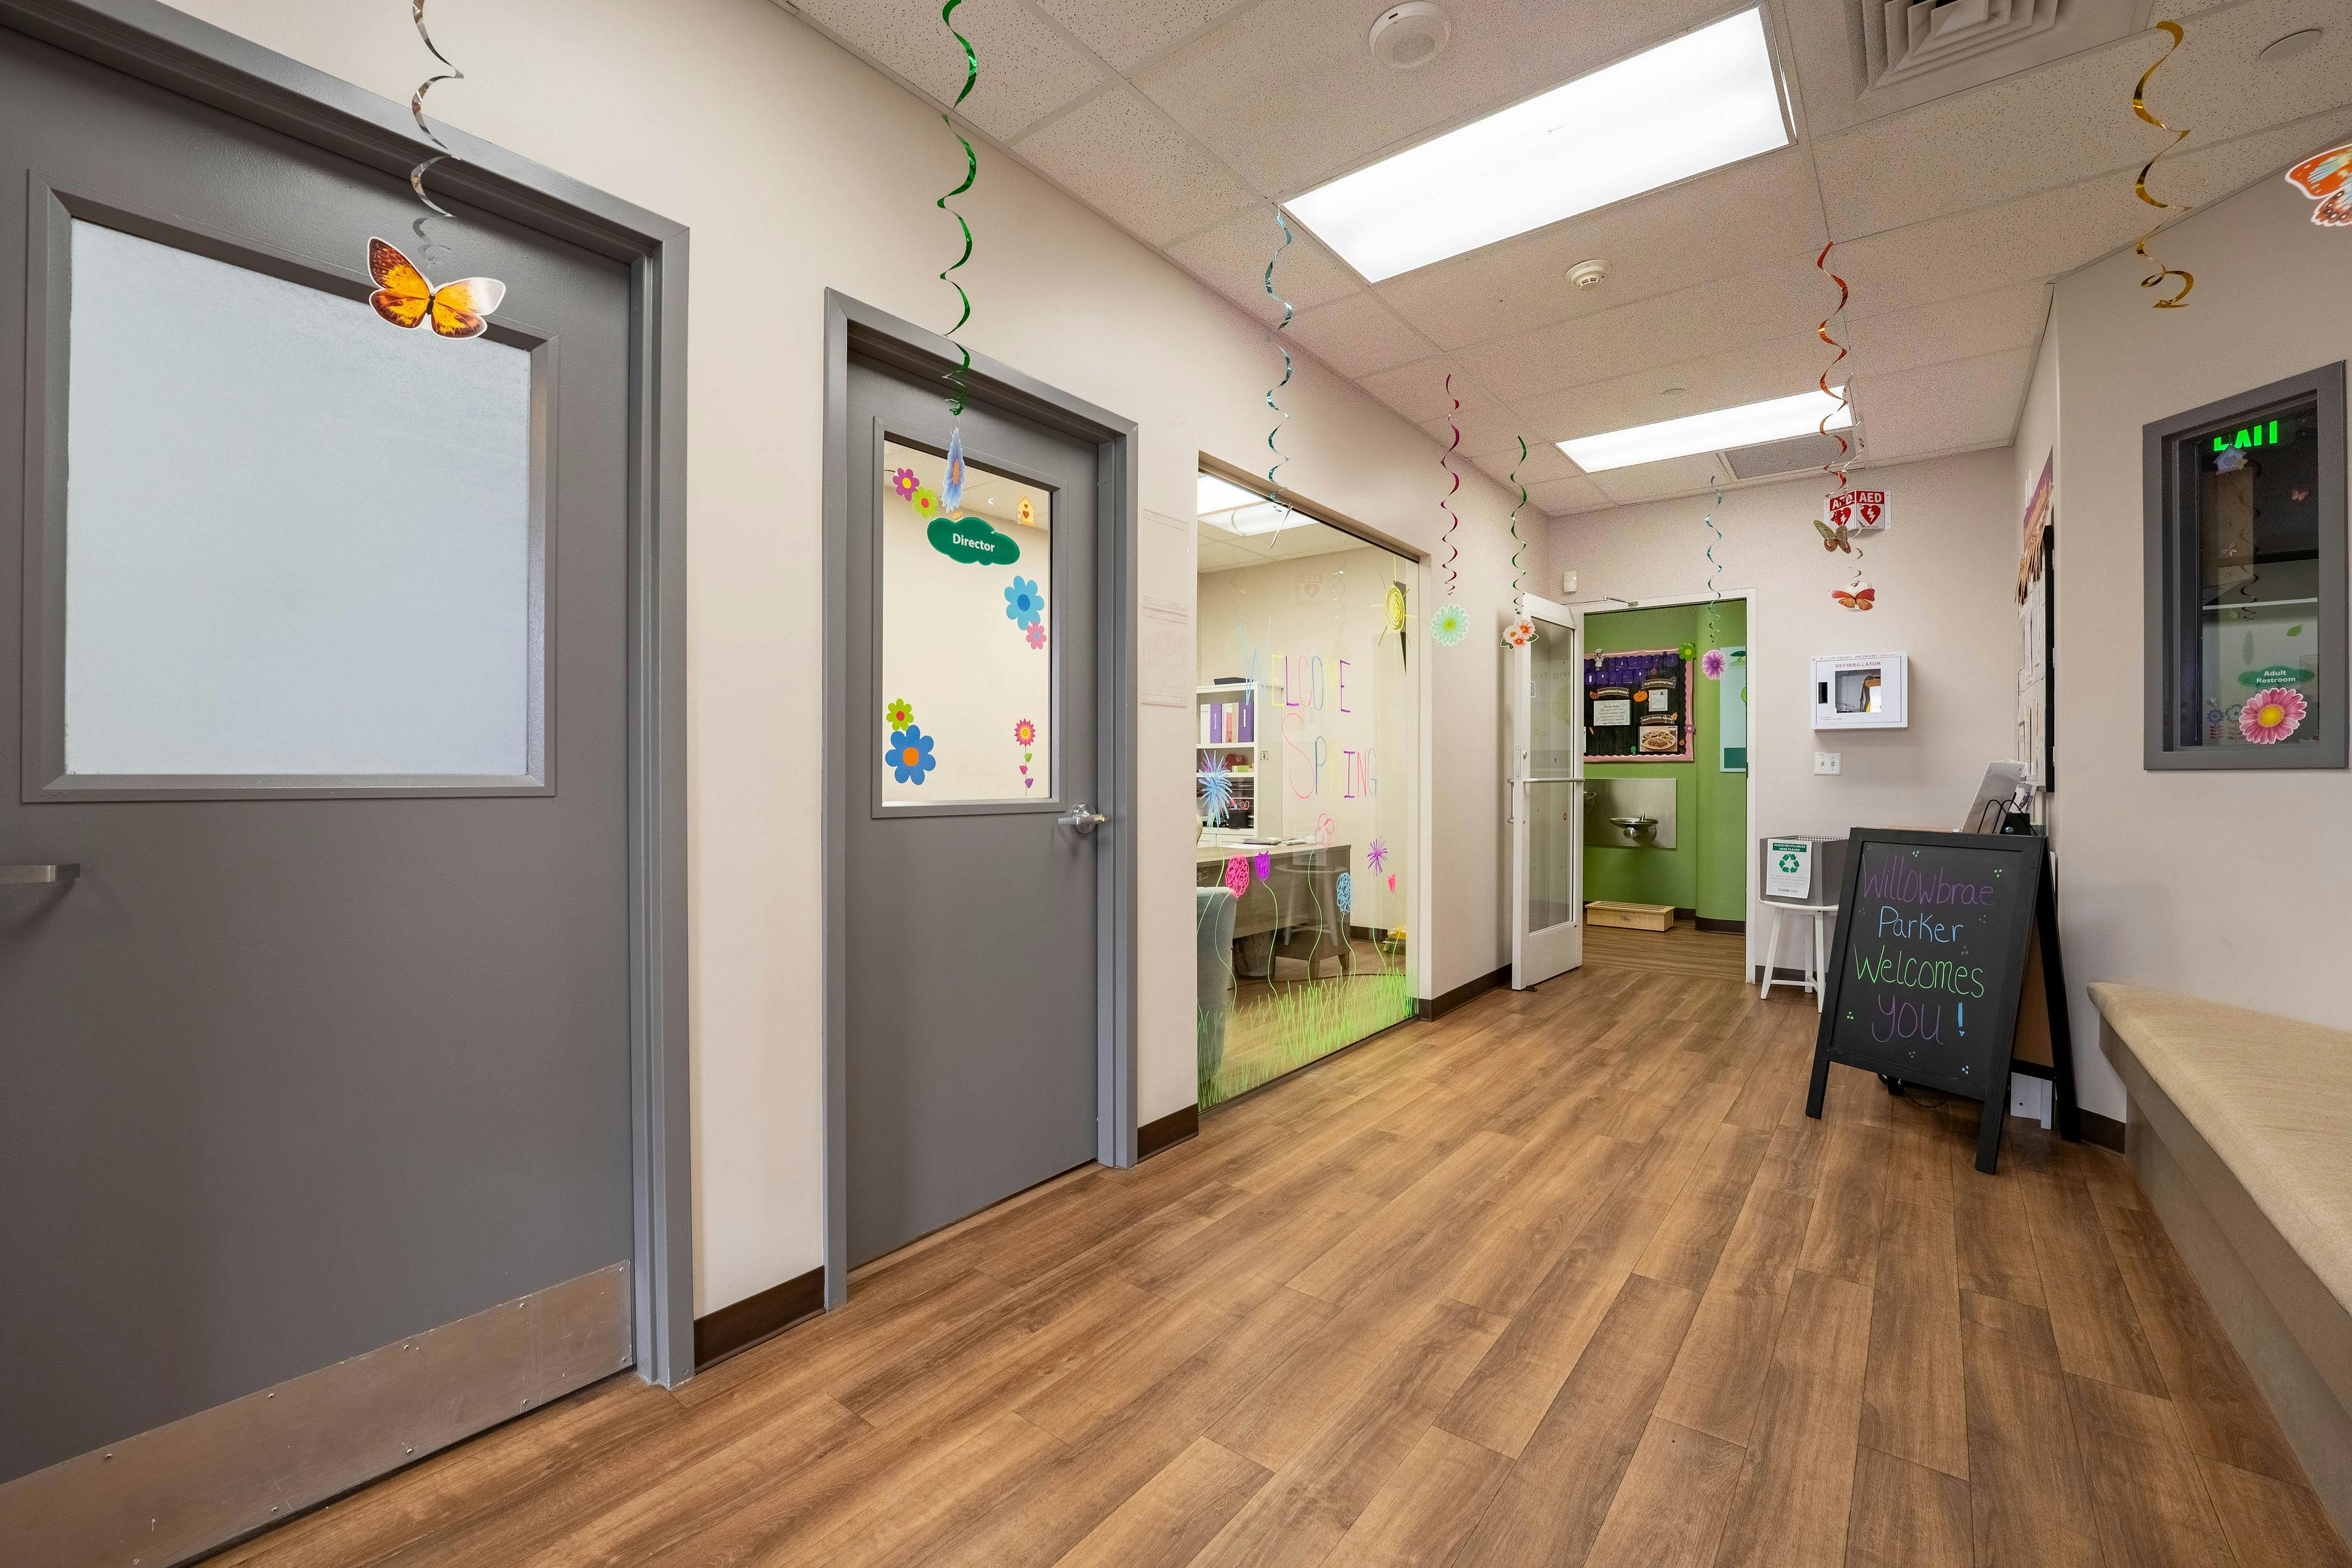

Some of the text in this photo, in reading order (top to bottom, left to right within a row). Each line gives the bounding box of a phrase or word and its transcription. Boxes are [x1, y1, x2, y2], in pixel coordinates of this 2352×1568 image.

[1859, 492, 1882, 502] AED
[953, 532, 995, 552] Director
[1237, 614, 1350, 713] WELCOME
[1282, 713, 1377, 804] SPRING
[1862, 853, 1996, 906] Willowbrae
[1854, 944, 1984, 998] Welcomes
